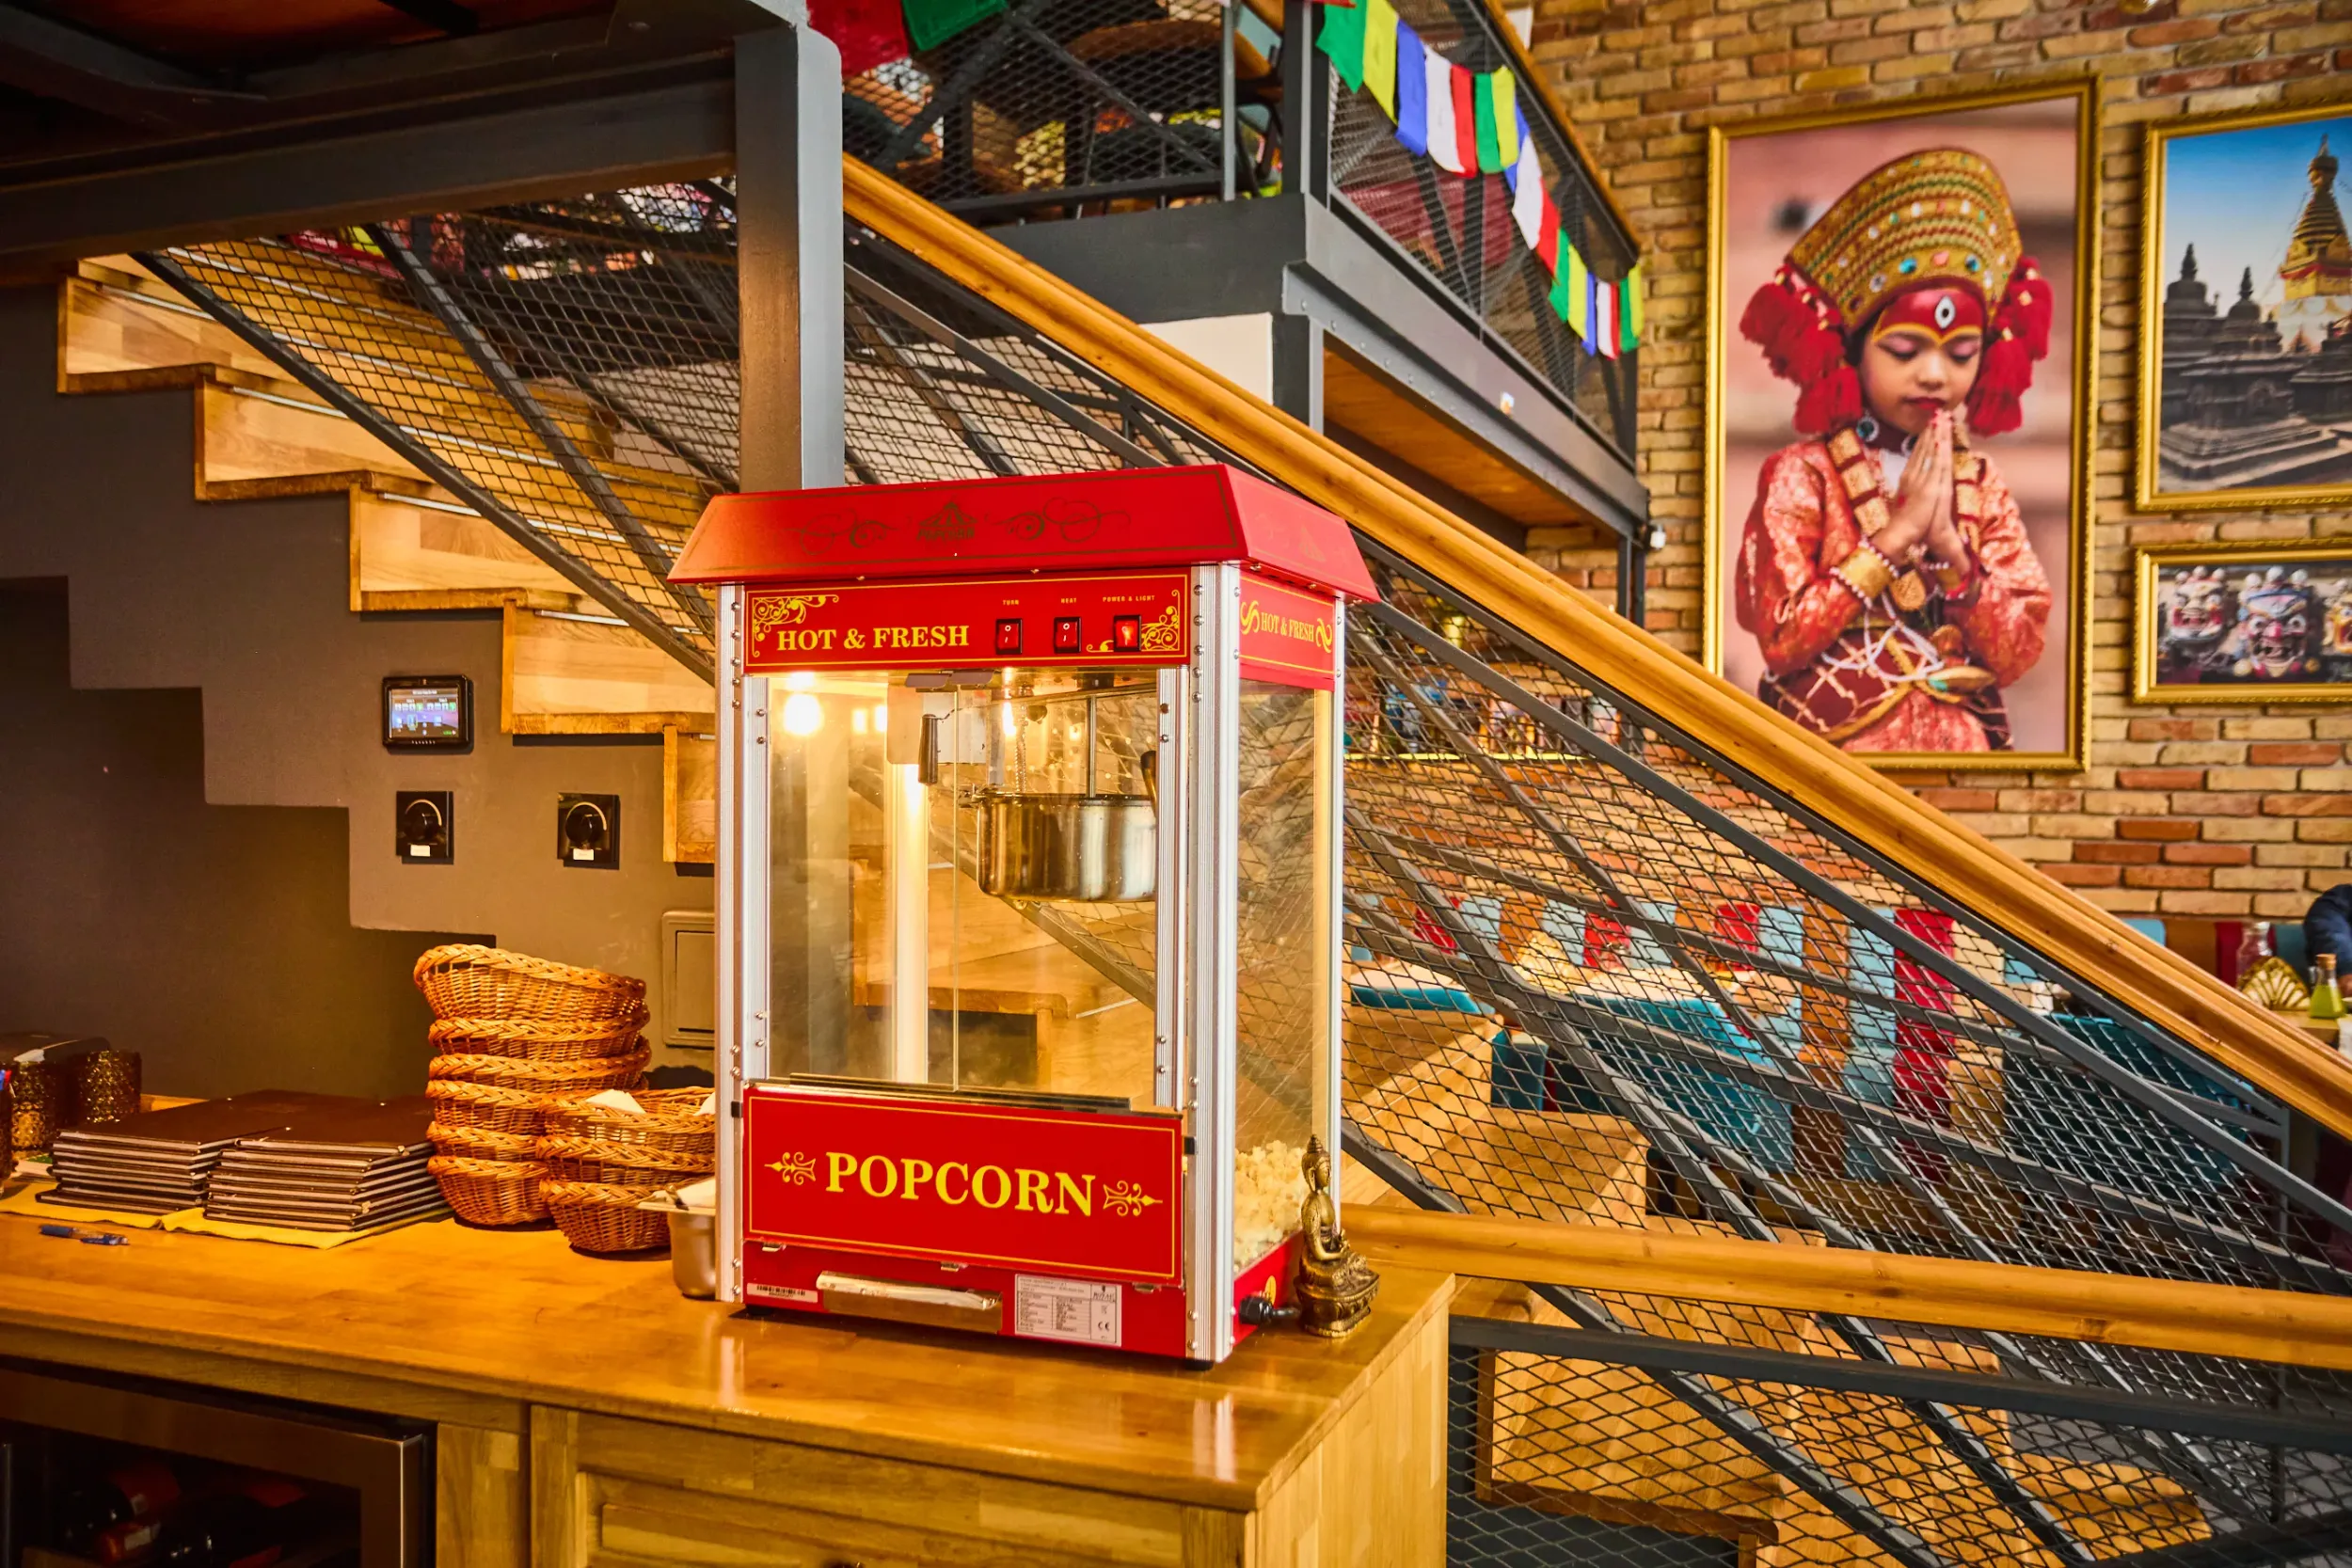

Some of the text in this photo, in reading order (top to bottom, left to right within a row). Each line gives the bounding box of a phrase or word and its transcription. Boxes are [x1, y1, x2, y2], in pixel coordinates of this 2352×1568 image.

[776, 626, 970, 651] HOT & FRESH
[1261, 612, 1315, 642] HOT & FRESH
[825, 1150, 1096, 1217] POPCORN
